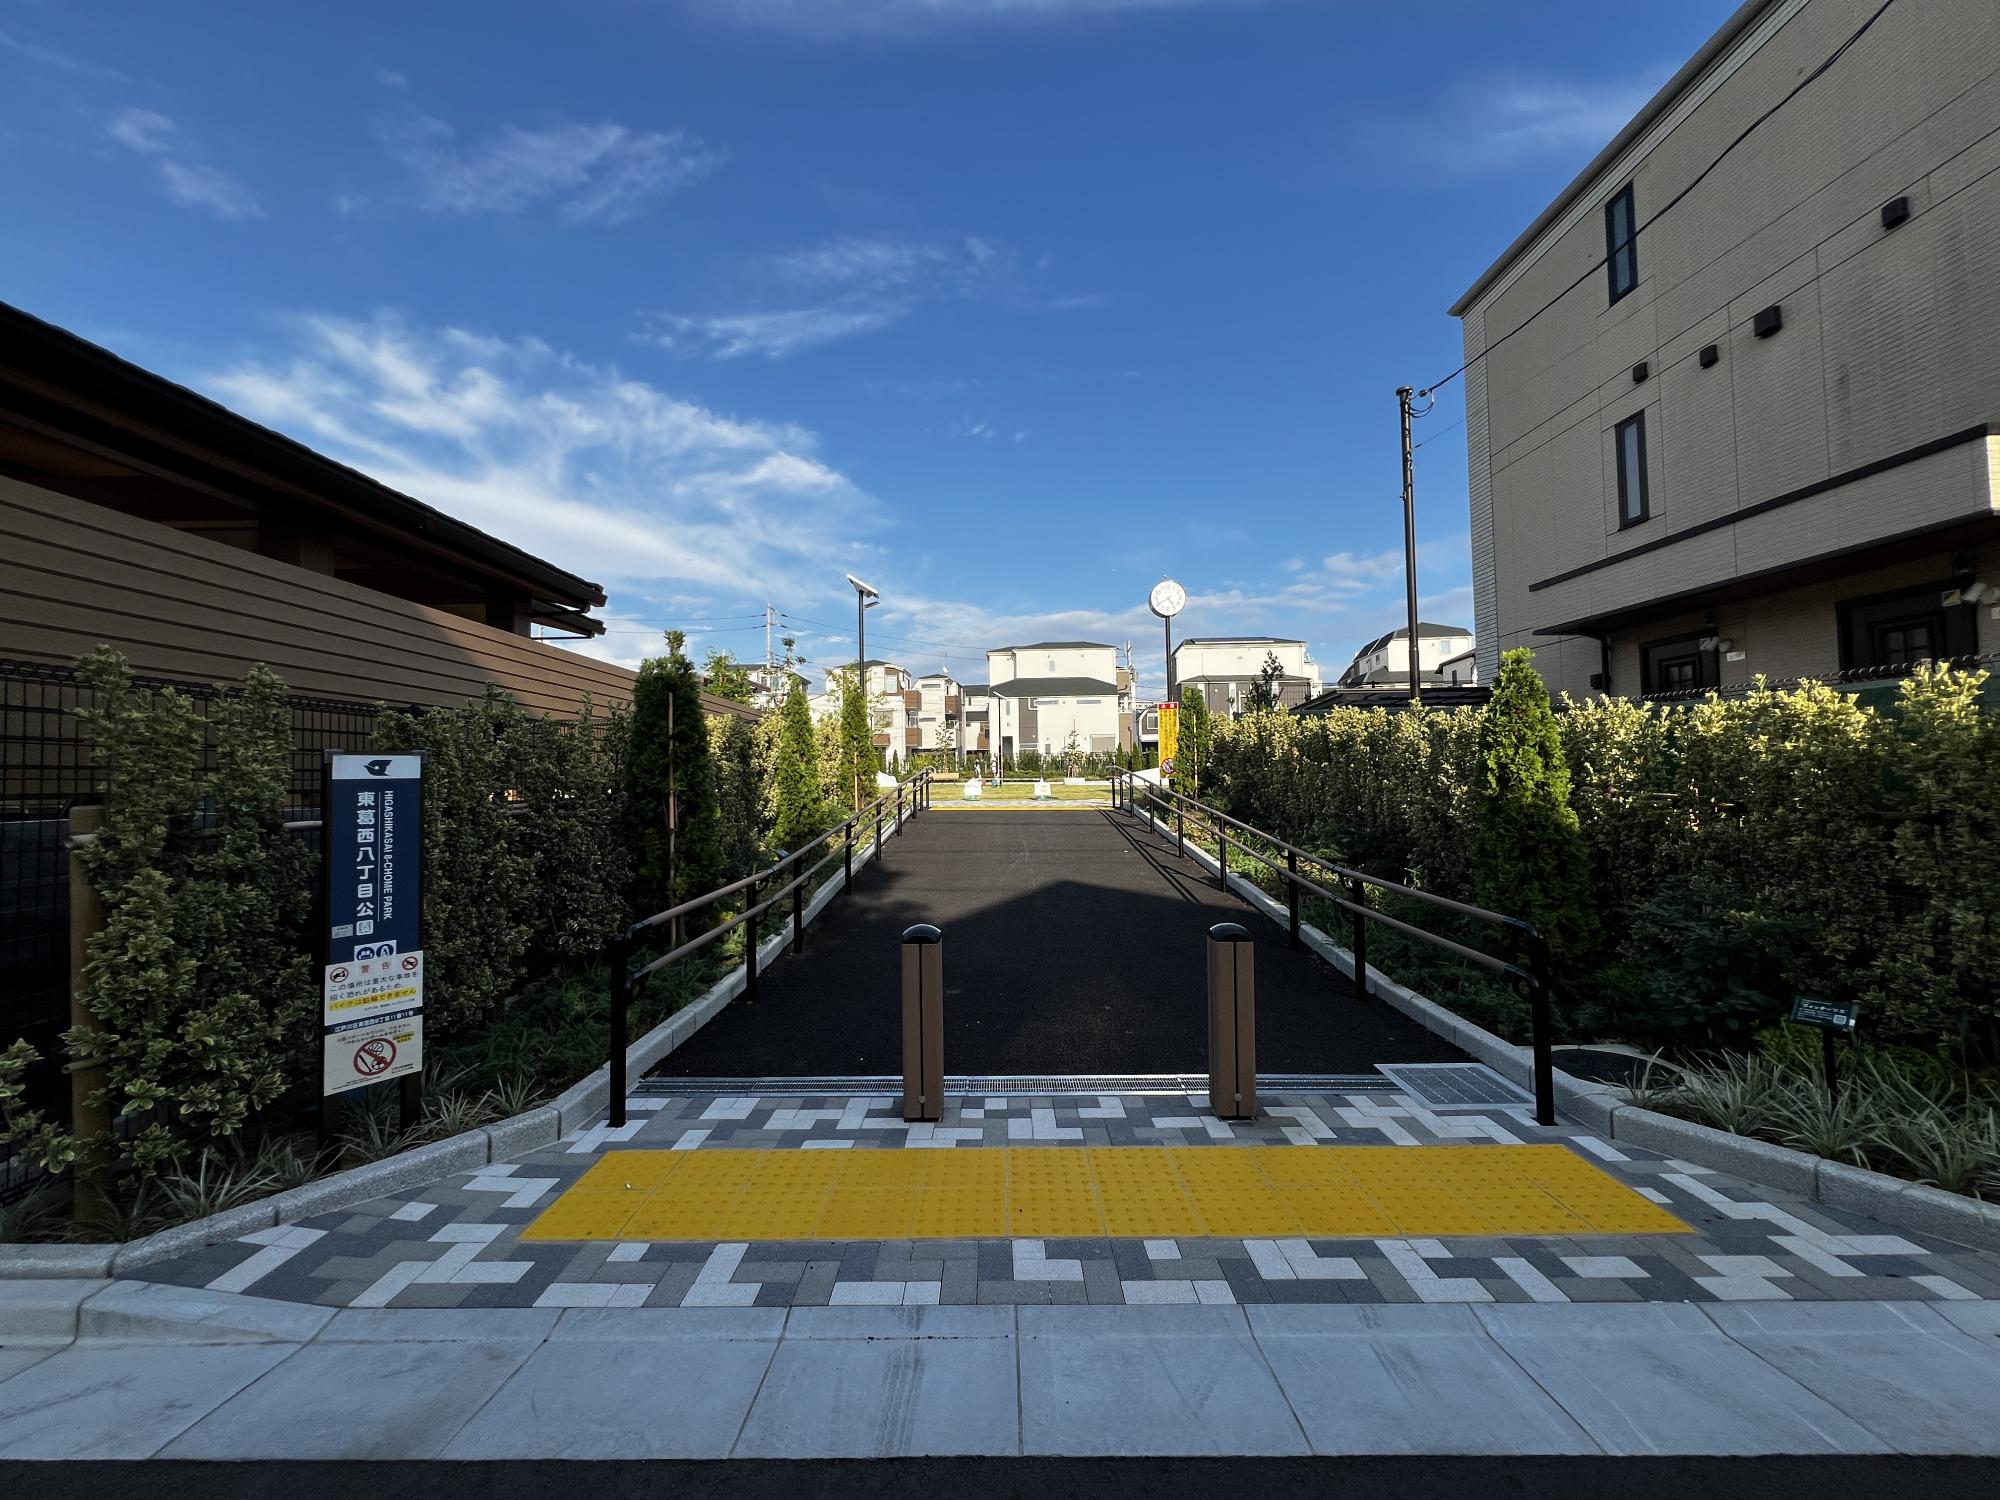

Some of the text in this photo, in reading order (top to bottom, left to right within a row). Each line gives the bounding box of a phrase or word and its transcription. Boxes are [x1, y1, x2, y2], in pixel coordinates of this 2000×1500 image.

[356, 791, 376, 936] 東葛西八丁目公園
[383, 790, 394, 920] HIGASHIKASAI 8-CHOME PARK
